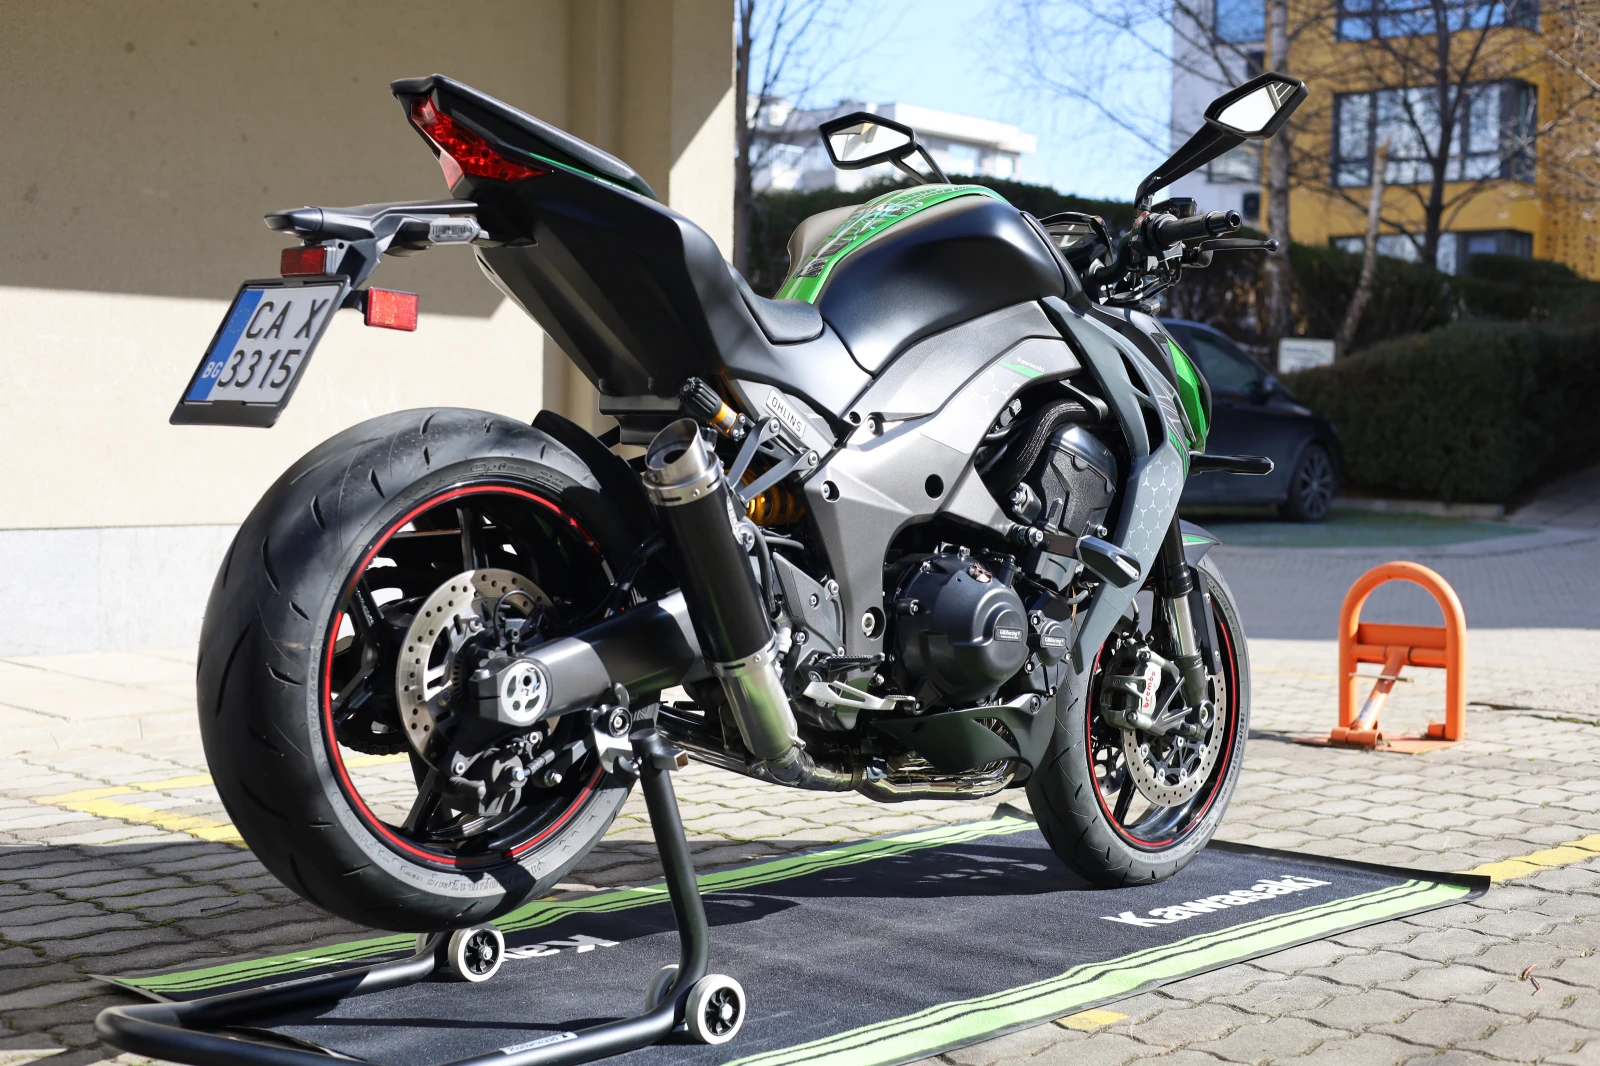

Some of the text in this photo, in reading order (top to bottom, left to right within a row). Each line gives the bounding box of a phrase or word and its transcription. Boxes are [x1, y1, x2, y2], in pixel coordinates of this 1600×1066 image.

[246, 299, 330, 340] CA X
[201, 361, 224, 379] BG
[217, 348, 303, 390] 3315
[1142, 671, 1156, 709] brembo
[1099, 874, 1332, 928] Kawasaki
